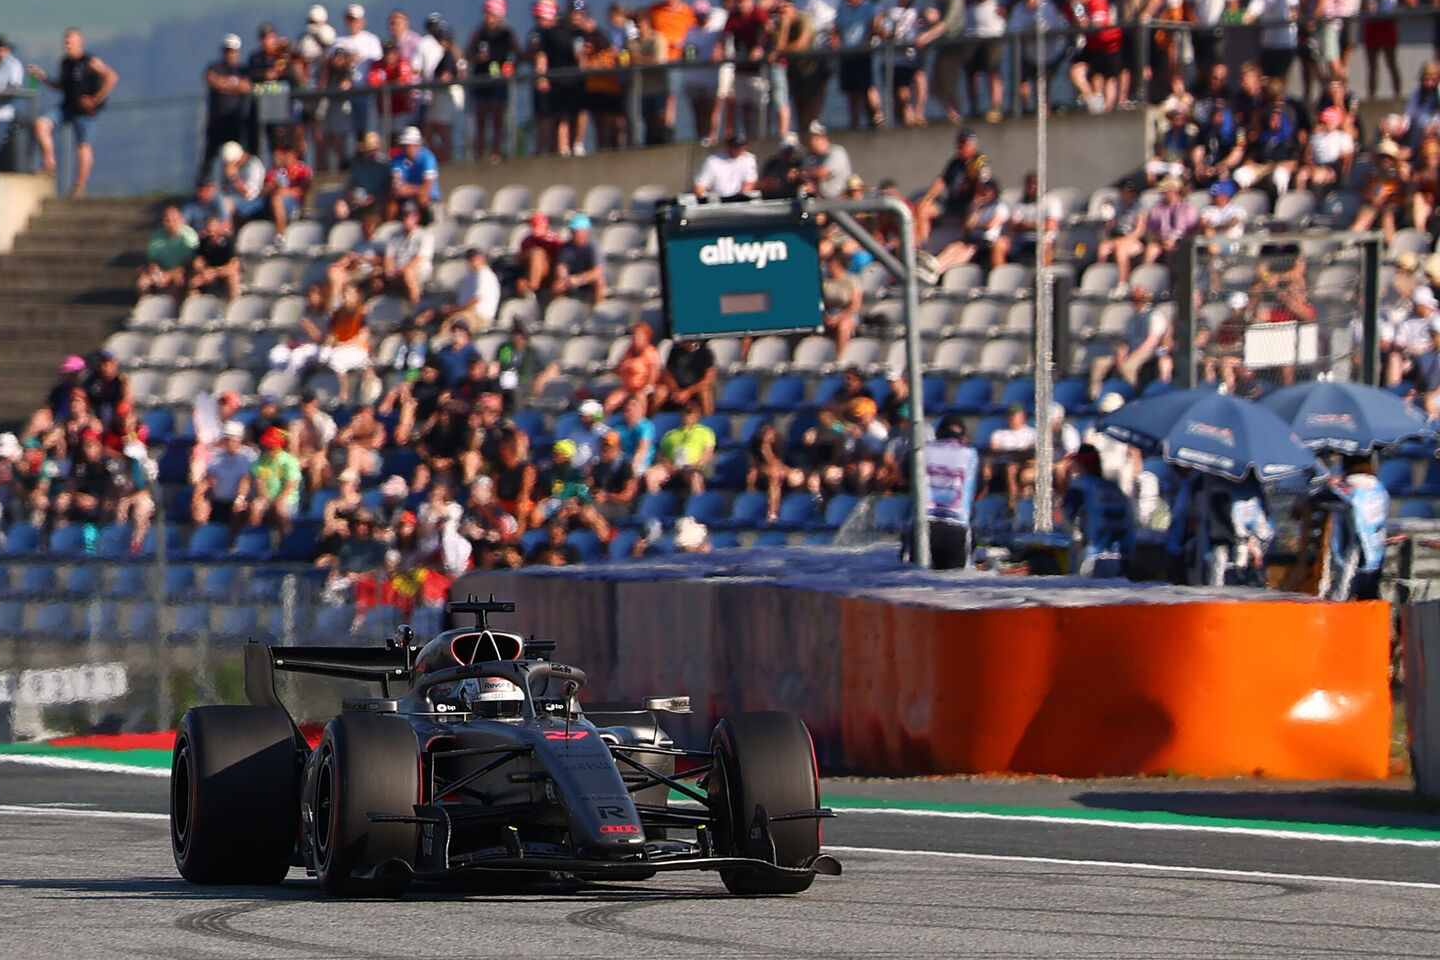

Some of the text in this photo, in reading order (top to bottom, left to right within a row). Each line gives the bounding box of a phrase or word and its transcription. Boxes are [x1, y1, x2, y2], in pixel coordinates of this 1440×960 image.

[699, 236, 788, 269] allwyn
[484, 682, 512, 690] Revolt
[597, 805, 629, 820] R
